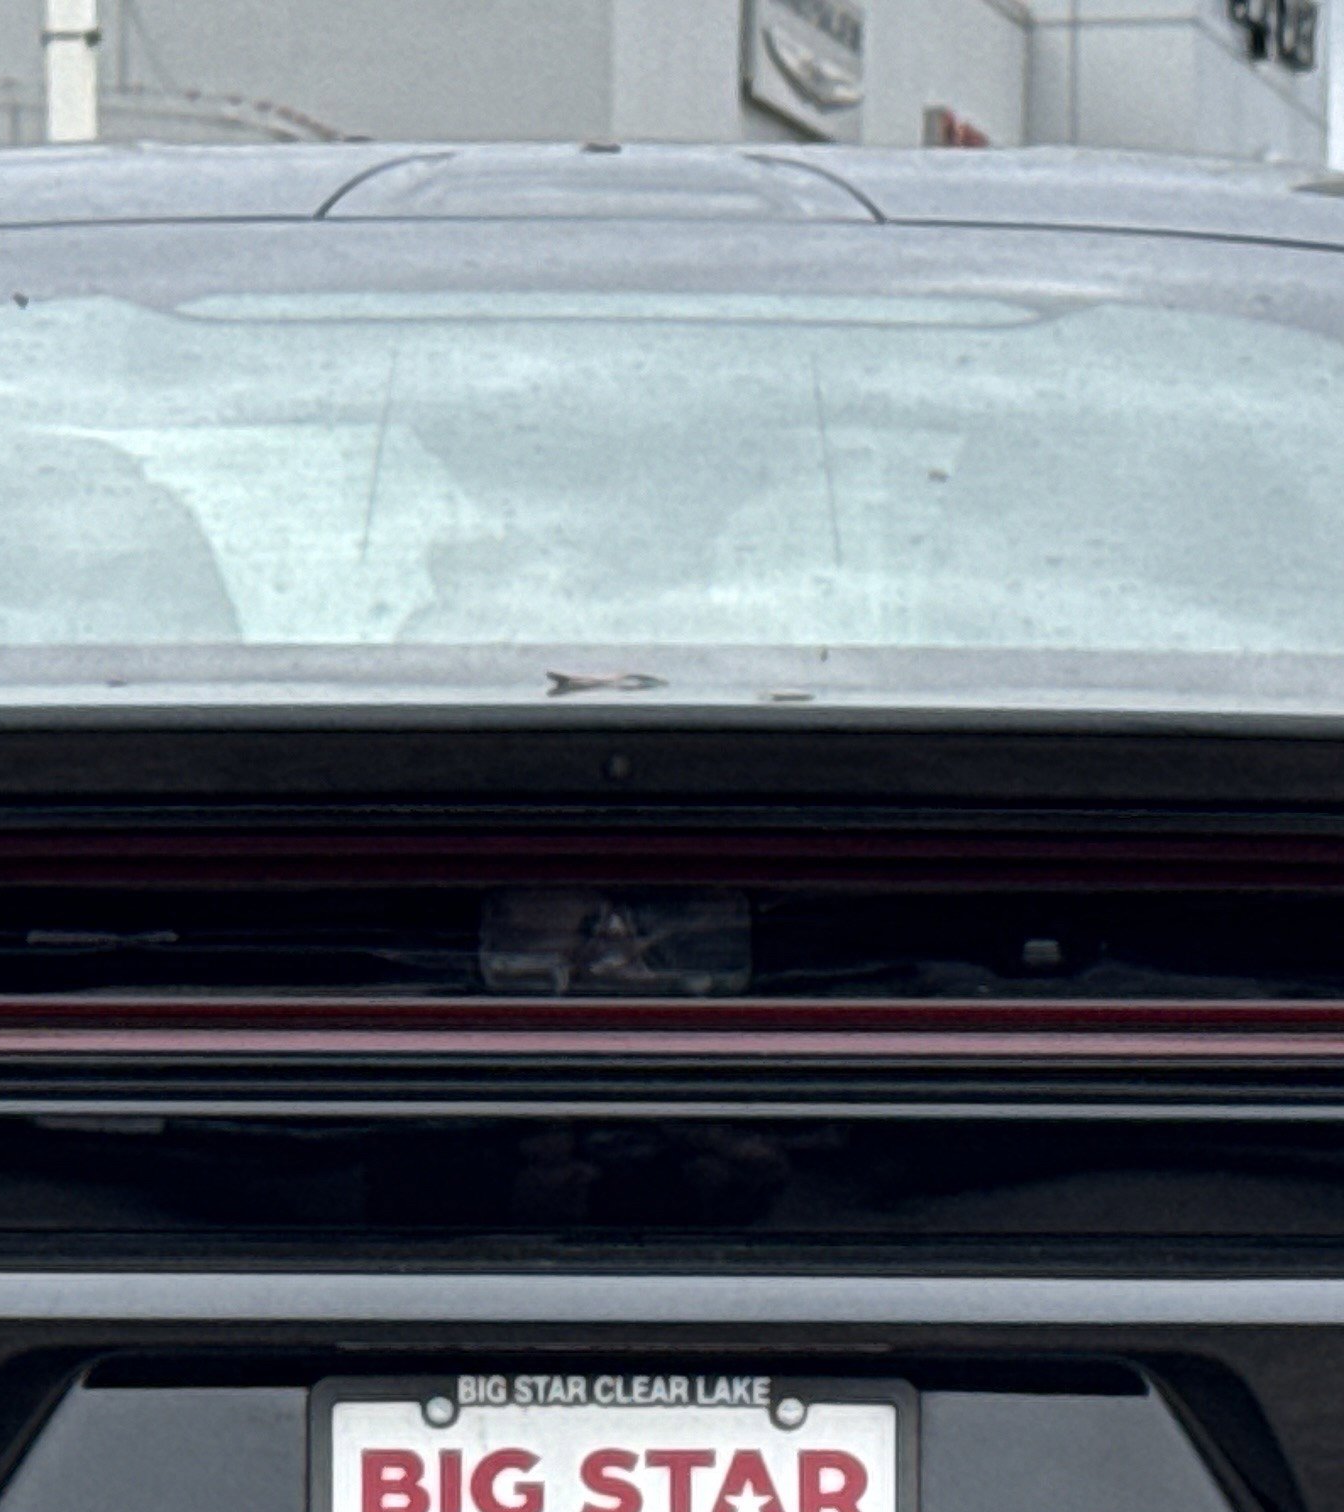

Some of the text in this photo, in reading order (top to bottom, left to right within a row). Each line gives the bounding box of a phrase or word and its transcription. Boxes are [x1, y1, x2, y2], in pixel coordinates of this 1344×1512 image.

[458, 1375, 771, 1405] BIG STAR CLEAR LAKE
